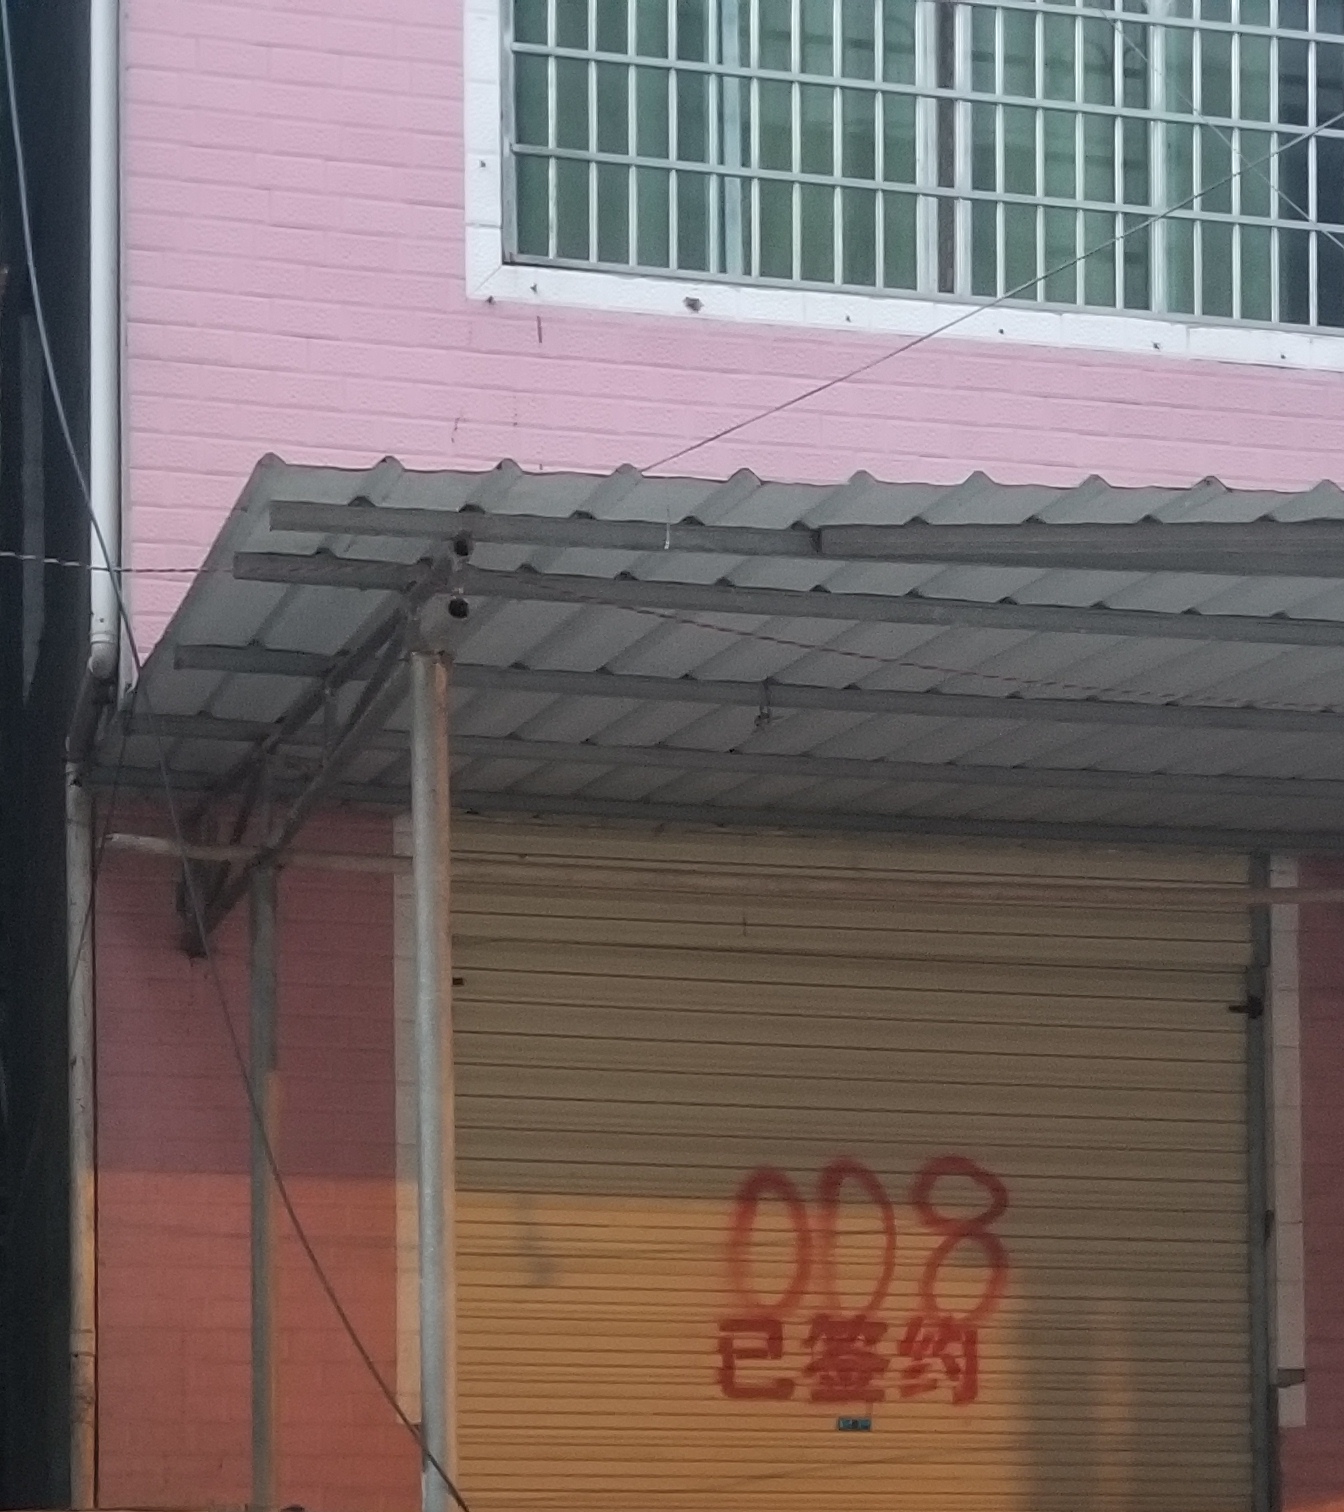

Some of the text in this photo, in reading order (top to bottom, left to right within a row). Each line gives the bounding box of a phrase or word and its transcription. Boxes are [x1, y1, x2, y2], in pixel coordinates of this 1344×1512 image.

[727, 1155, 1009, 1324] 008
[718, 1313, 979, 1405] 已签约
